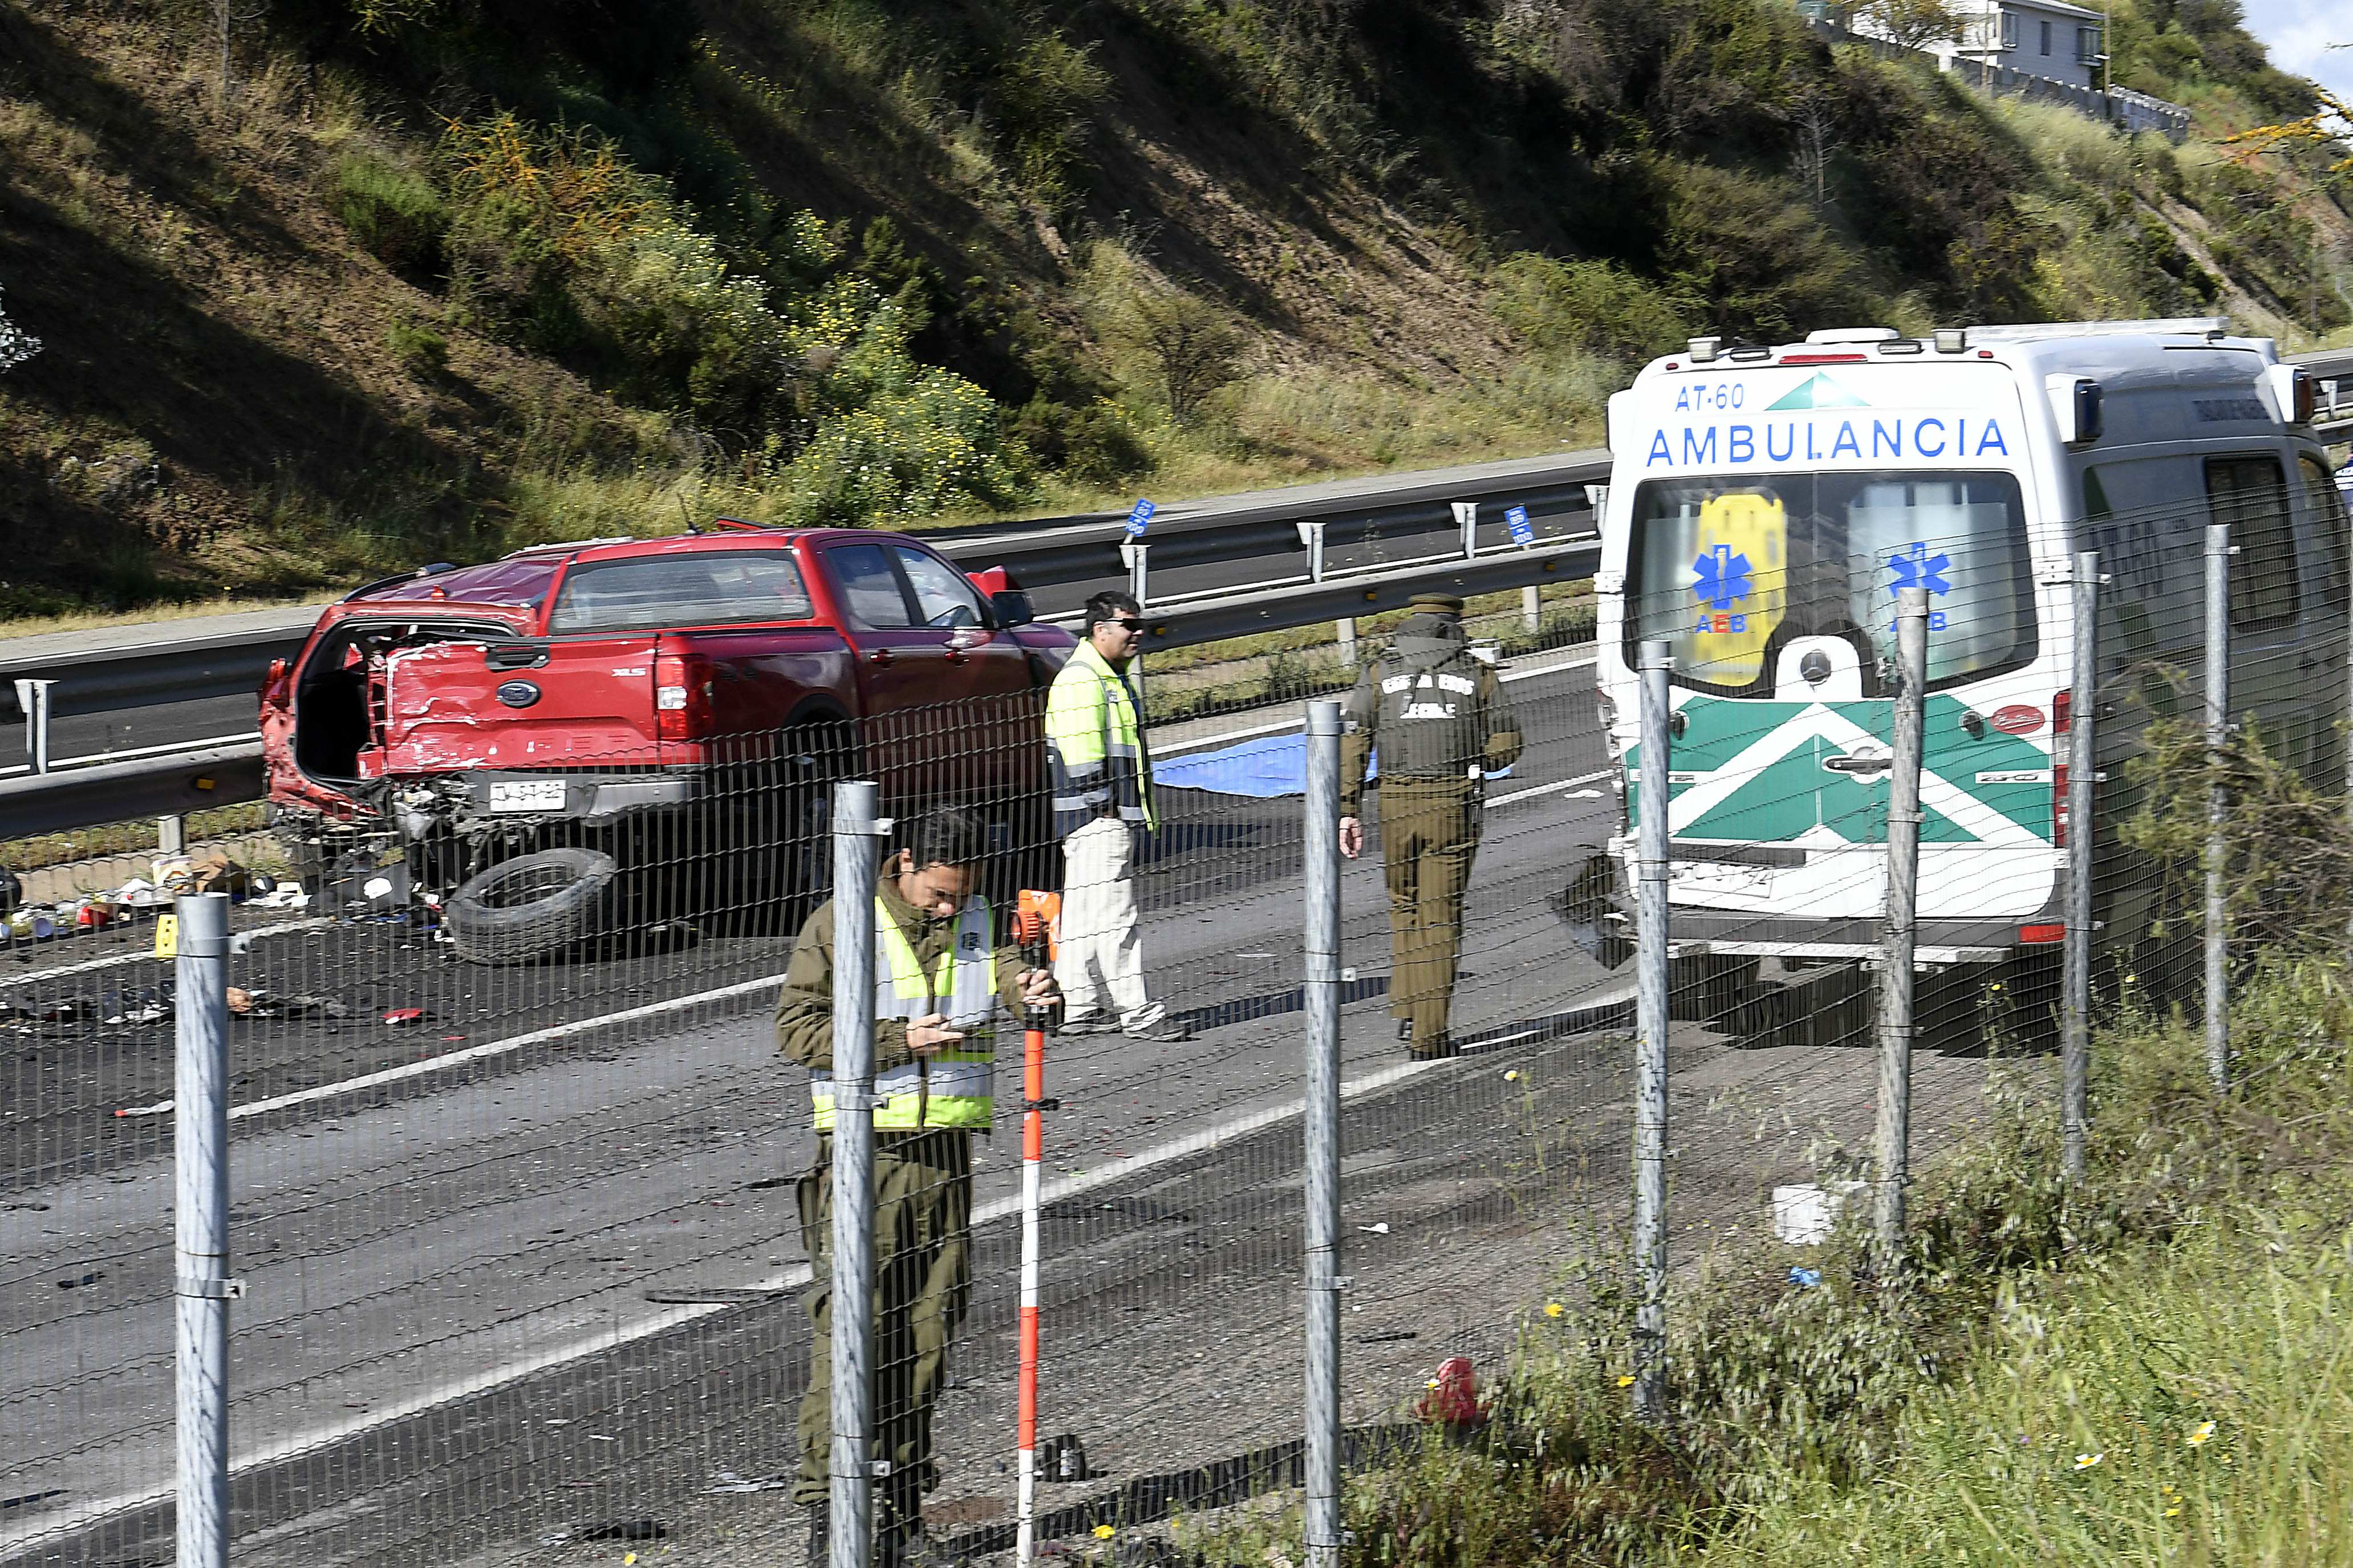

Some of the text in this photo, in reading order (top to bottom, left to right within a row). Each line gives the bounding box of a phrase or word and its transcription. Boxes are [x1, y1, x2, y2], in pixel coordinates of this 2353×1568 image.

[1646, 418, 2009, 467] AMBULANCIA
[1695, 614, 1747, 633] AEB
[611, 668, 646, 677] XLS
